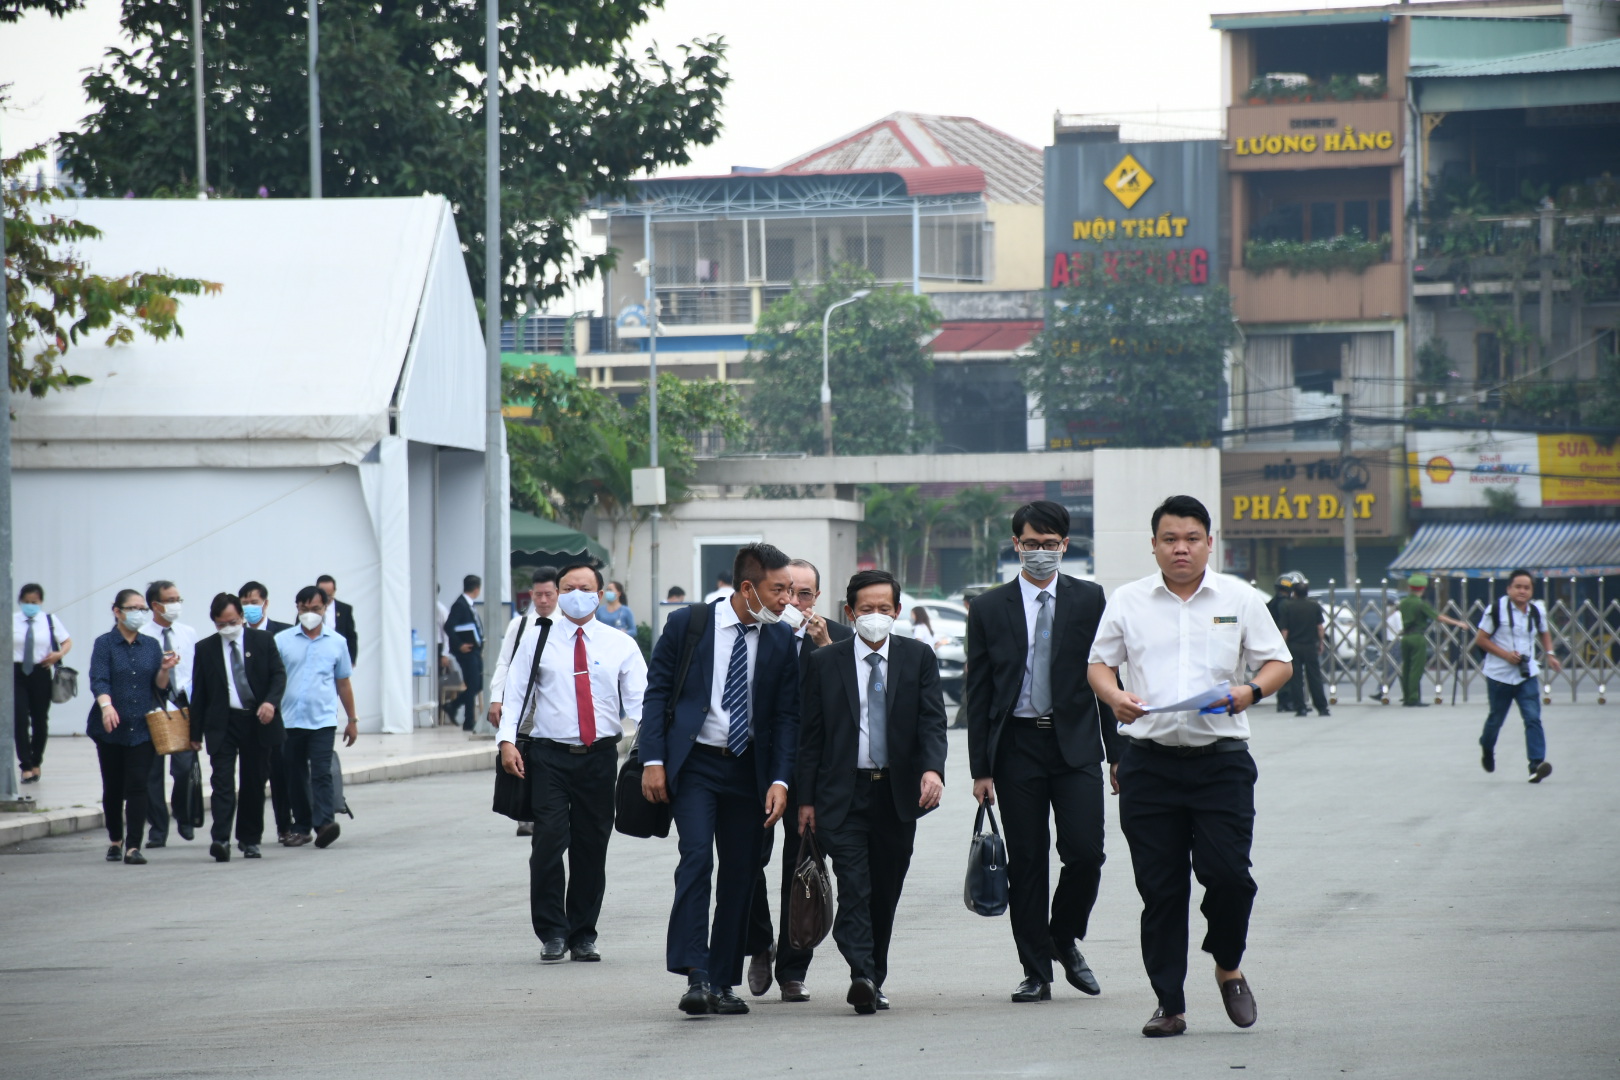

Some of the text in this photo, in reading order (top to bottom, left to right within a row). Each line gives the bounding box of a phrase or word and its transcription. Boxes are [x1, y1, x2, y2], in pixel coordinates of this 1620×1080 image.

[1235, 133, 1318, 155] LƯƠNG
[1072, 211, 1188, 243] NỘI THẤT
[1479, 454, 1502, 463] Shell
[1232, 487, 1312, 520] PHÁT
